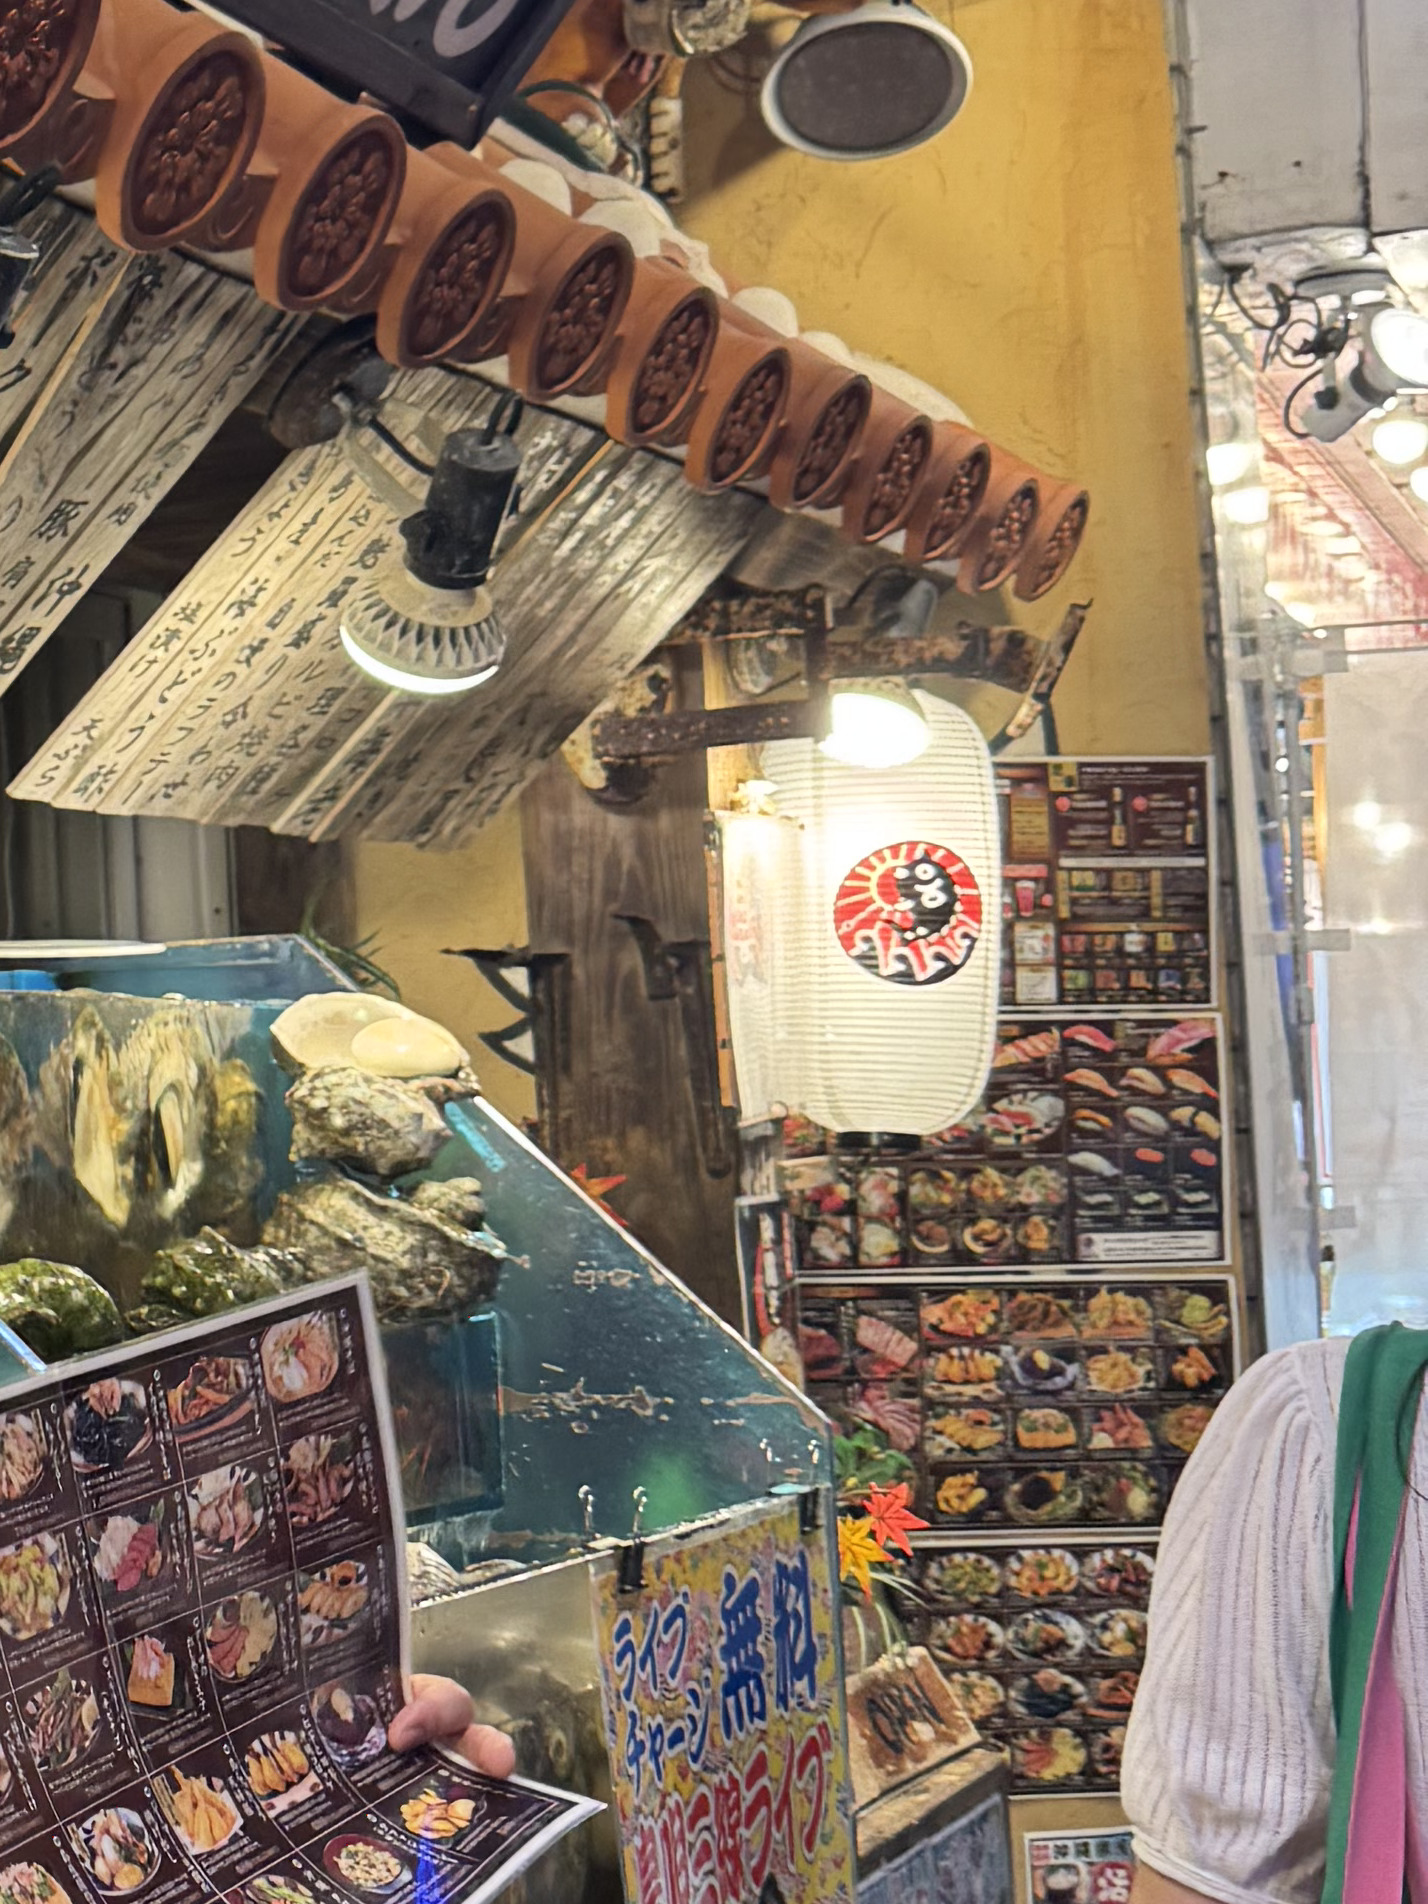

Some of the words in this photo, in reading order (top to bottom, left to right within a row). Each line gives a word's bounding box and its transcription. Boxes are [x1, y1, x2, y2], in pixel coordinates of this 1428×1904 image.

[316, 495, 386, 568] 込んだ
[614, 1586, 690, 1708] ライブ
[718, 1547, 820, 1747] 無料
[625, 1669, 712, 1794] チャージ
